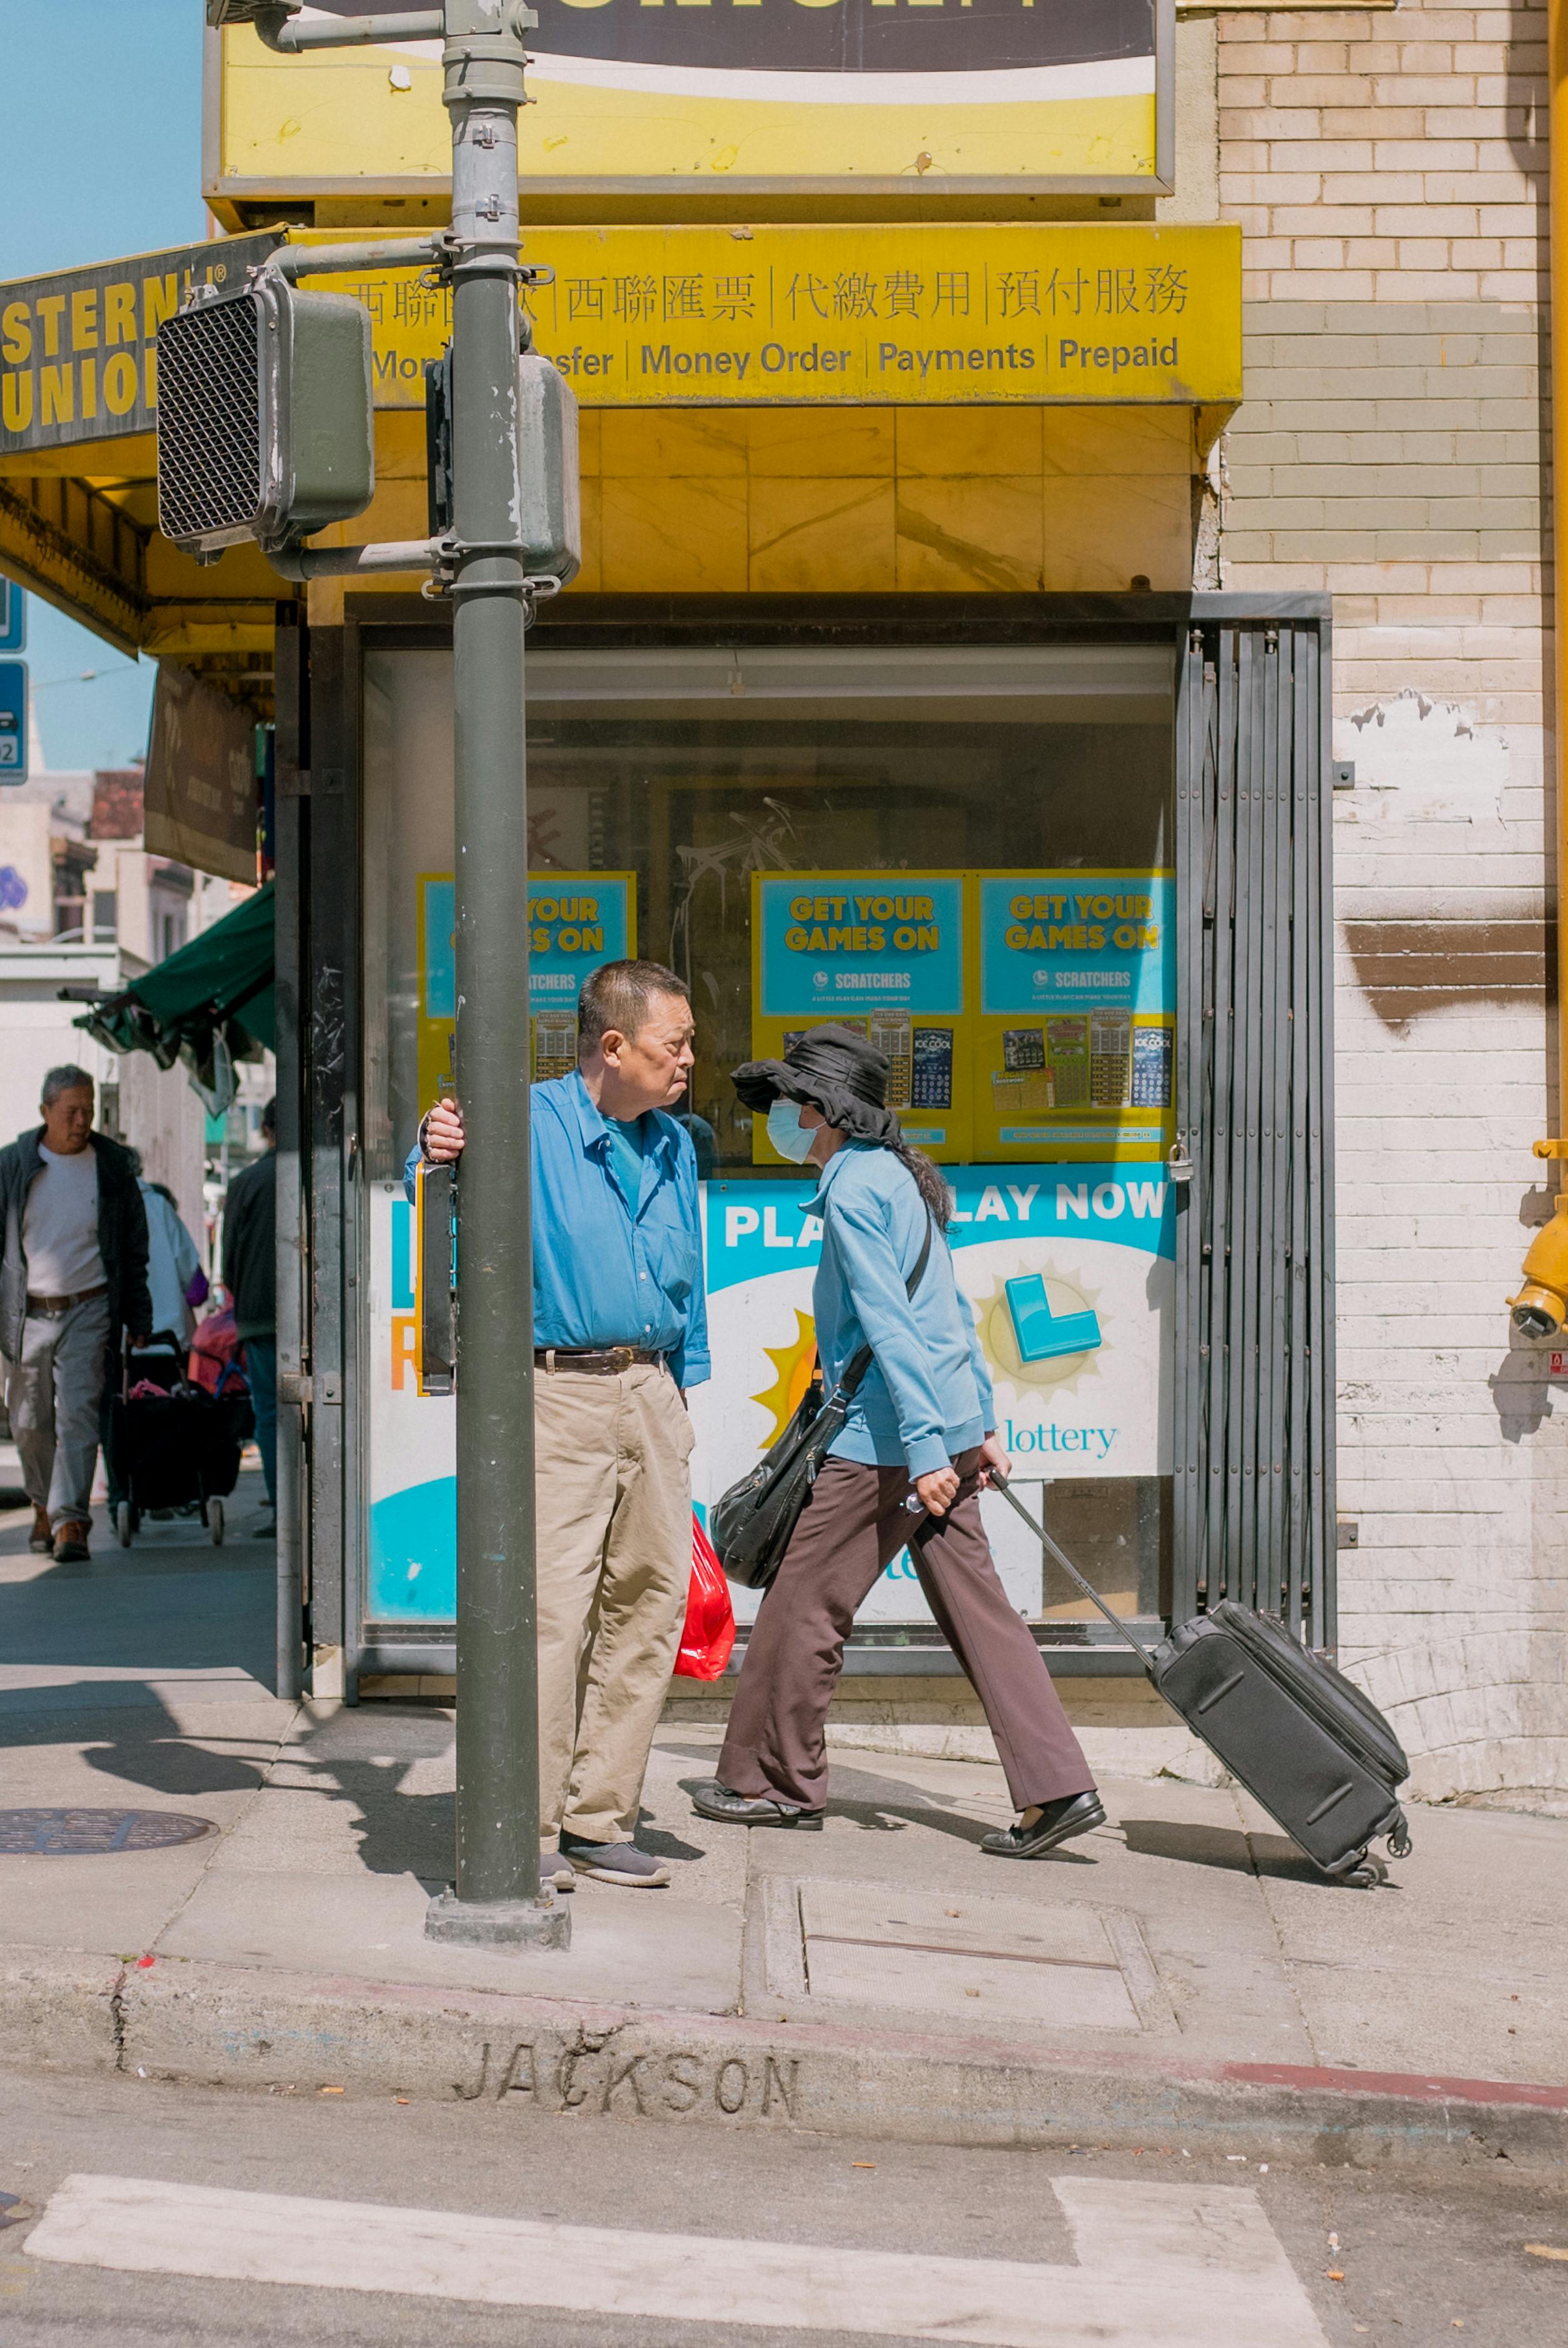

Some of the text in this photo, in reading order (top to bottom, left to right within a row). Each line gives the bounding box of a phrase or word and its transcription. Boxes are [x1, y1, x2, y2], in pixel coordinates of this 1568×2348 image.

[563, 273, 757, 323] 西聯匯票
[785, 270, 970, 321] 代繳費用
[997, 263, 1188, 319] 預付服務
[642, 343, 851, 380] Money Order
[879, 341, 1035, 378] Payments
[1060, 338, 1178, 373] Prepaid
[789, 895, 934, 921] GET YOUR
[1009, 895, 1153, 920] GET YOUR
[558, 927, 604, 952] ON
[785, 926, 939, 951] GAMES ON
[1004, 925, 1159, 950] GAMES ON
[835, 972, 911, 989] SCRATCHERS
[1055, 971, 1131, 988] SCRATCHERS
[1056, 1181, 1166, 1220] NOW
[1004, 1419, 1119, 1460] lottery
[451, 2043, 801, 2119] JACKSON
